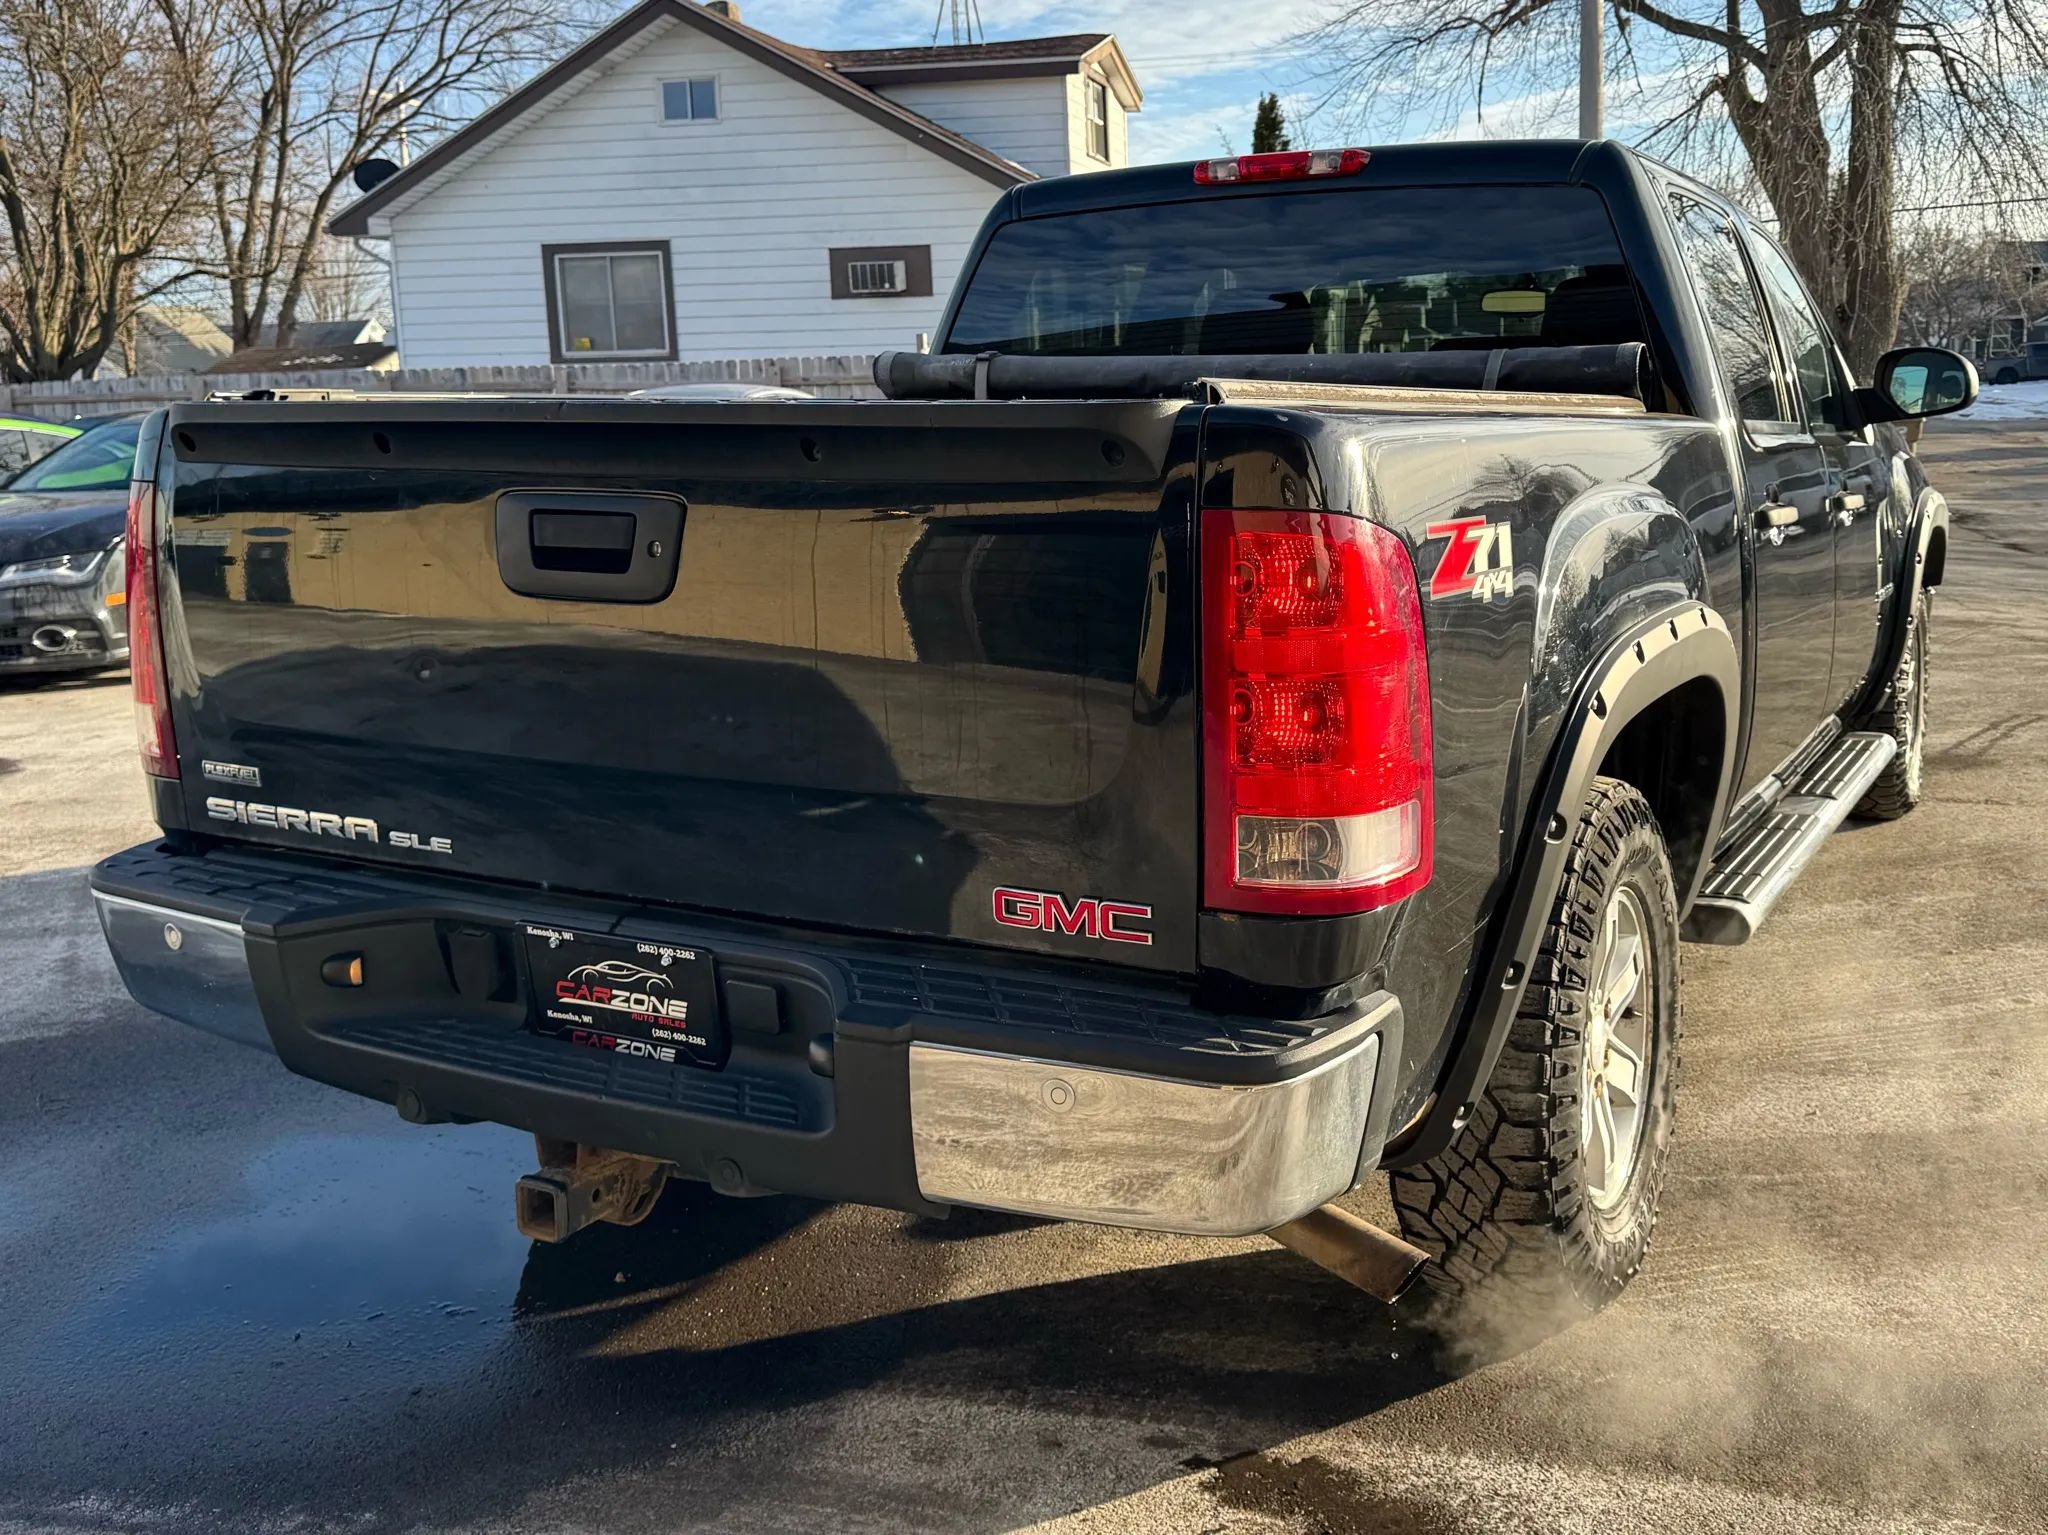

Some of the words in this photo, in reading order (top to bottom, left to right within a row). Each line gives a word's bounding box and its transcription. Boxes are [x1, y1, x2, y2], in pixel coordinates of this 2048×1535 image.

[1426, 514, 1513, 601] Z71
[204, 763, 257, 780] FLEXFUEL
[206, 796, 379, 844] SIERRA
[388, 830, 453, 854] SLE
[992, 886, 1153, 946] GMC
[526, 925, 562, 940] Kenosha,
[562, 931, 574, 941] WI
[636, 942, 658, 956] (262)
[658, 946, 696, 960] 400-2262
[546, 1009, 581, 1023] Kenosha,
[581, 1014, 593, 1024] WI
[631, 1012, 655, 1023] AUTO
[657, 1017, 687, 1029] SALES
[651, 1027, 672, 1041] (262)
[672, 1032, 707, 1046] 400-2262
